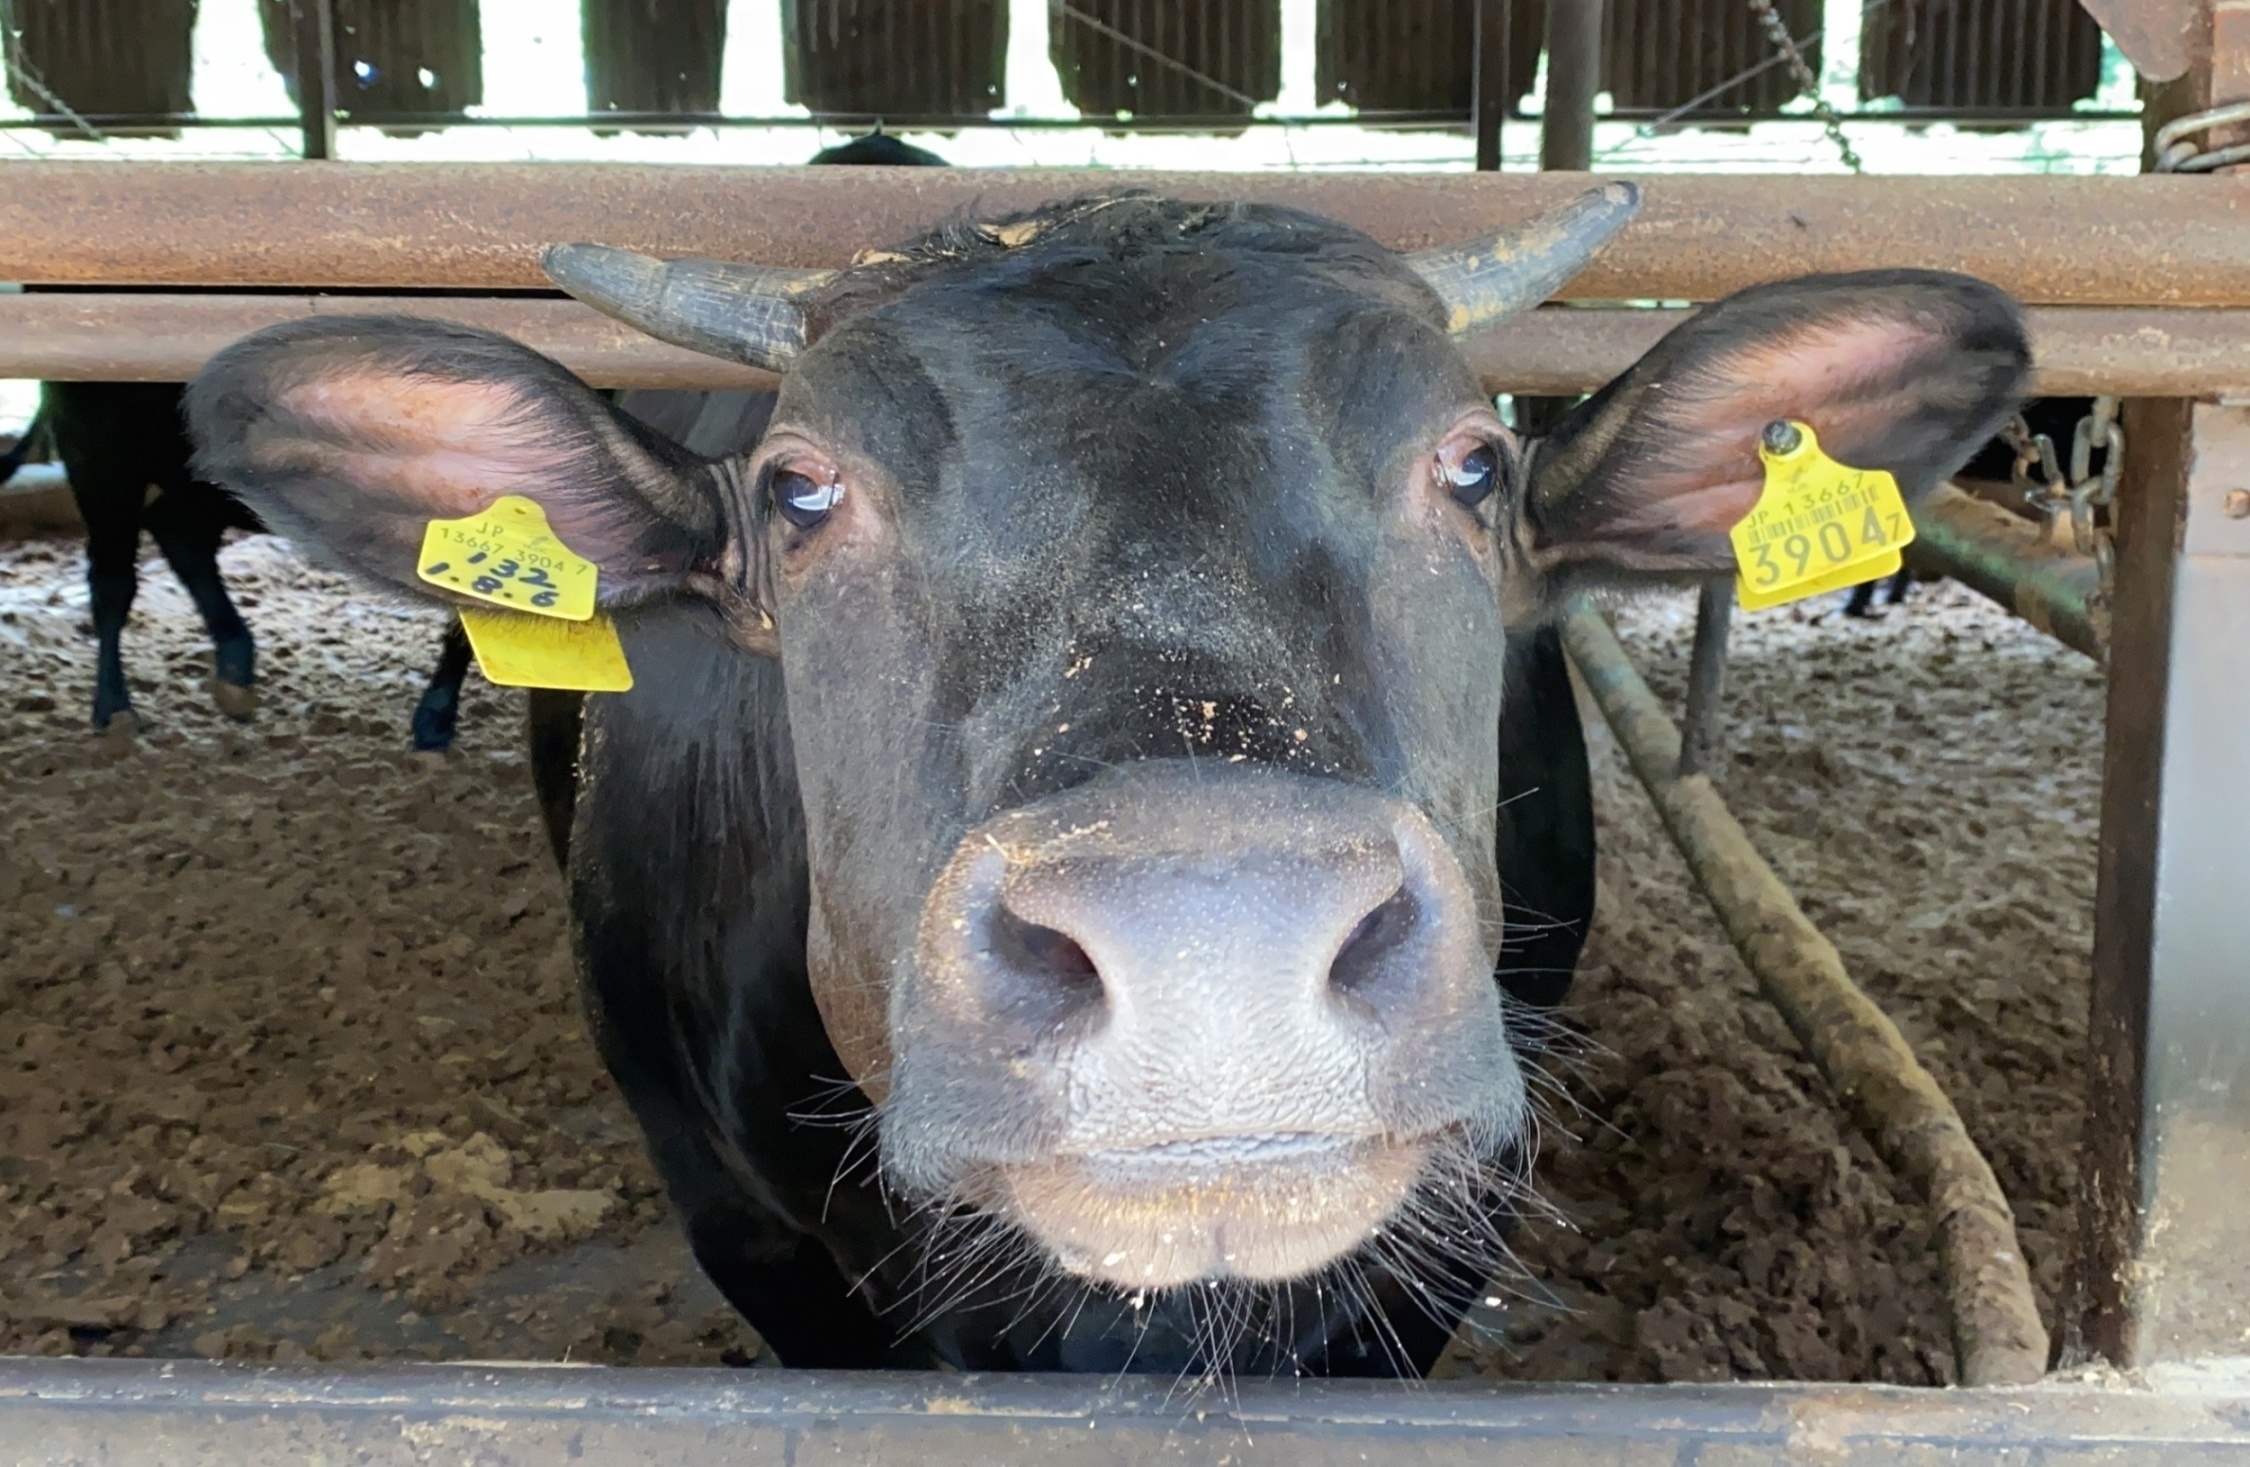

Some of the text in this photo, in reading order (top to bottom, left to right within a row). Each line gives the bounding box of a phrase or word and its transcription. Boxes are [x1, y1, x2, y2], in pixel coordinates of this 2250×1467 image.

[1747, 472, 1865, 529] JP 13667
[440, 527, 505, 555] 13667
[476, 522, 505, 537] JP
[466, 551, 558, 589] 132
